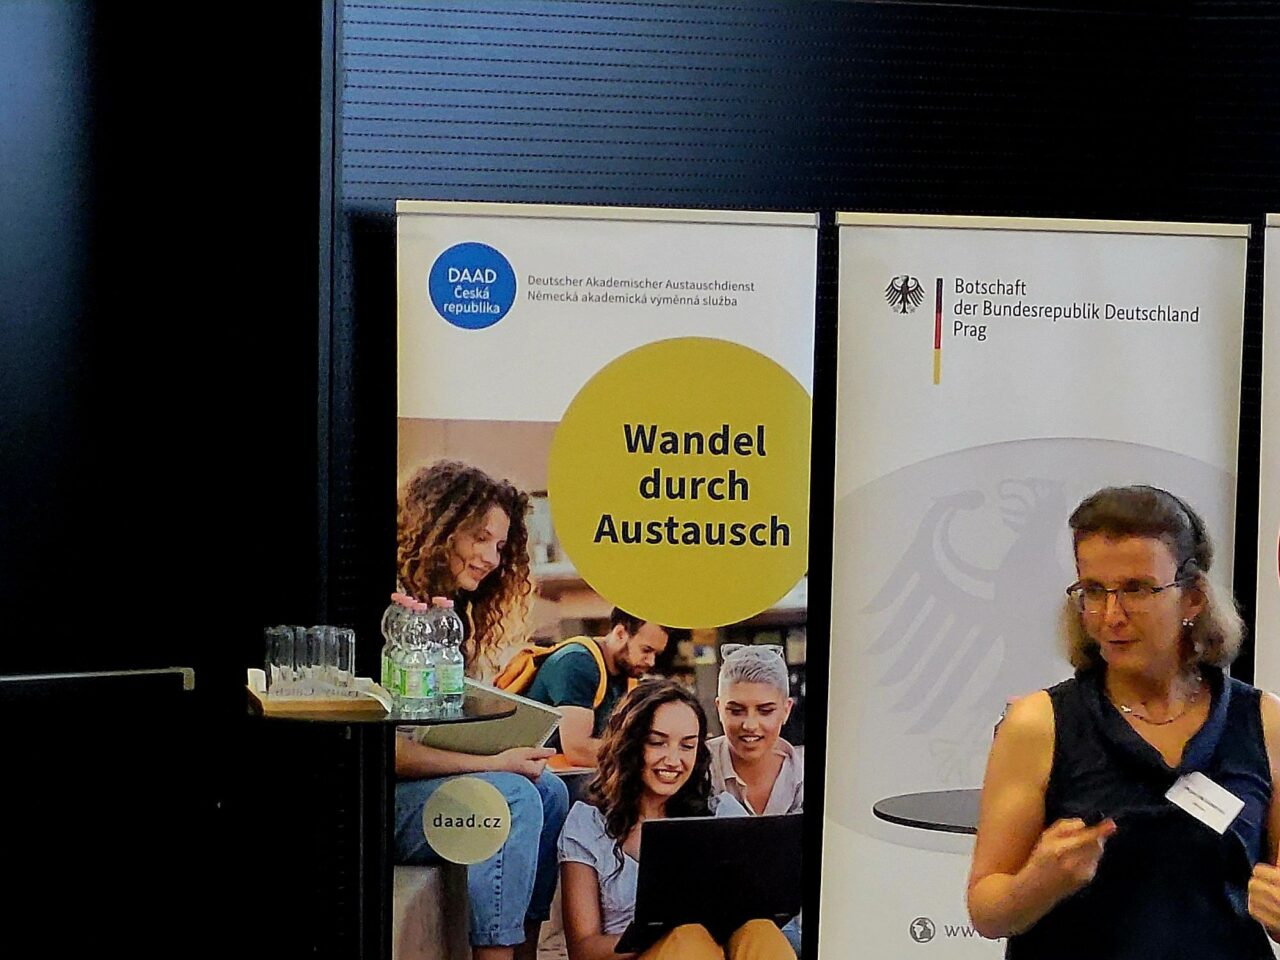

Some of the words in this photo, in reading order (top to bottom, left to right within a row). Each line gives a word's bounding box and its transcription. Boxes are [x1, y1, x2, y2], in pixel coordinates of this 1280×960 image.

[447, 267, 497, 284] DAAD
[527, 275, 583, 287] Deutscher
[585, 276, 664, 289] Akademischer
[665, 278, 755, 292] Austauschdienst
[454, 284, 490, 300] Česká
[955, 278, 1027, 296] Botschaft
[527, 289, 579, 302] Německá
[581, 290, 648, 304] akademická
[650, 292, 700, 307] výměnná
[702, 293, 738, 307] služba
[443, 300, 501, 316] republika
[953, 300, 978, 316] der
[983, 301, 1100, 322] Bundesrepublik
[1104, 304, 1200, 322] Deutschland
[953, 321, 987, 341] Prag
[623, 424, 767, 457] Wandel
[639, 469, 750, 501] durch
[593, 514, 791, 547] Austausch
[433, 813, 502, 828] daad.cz
